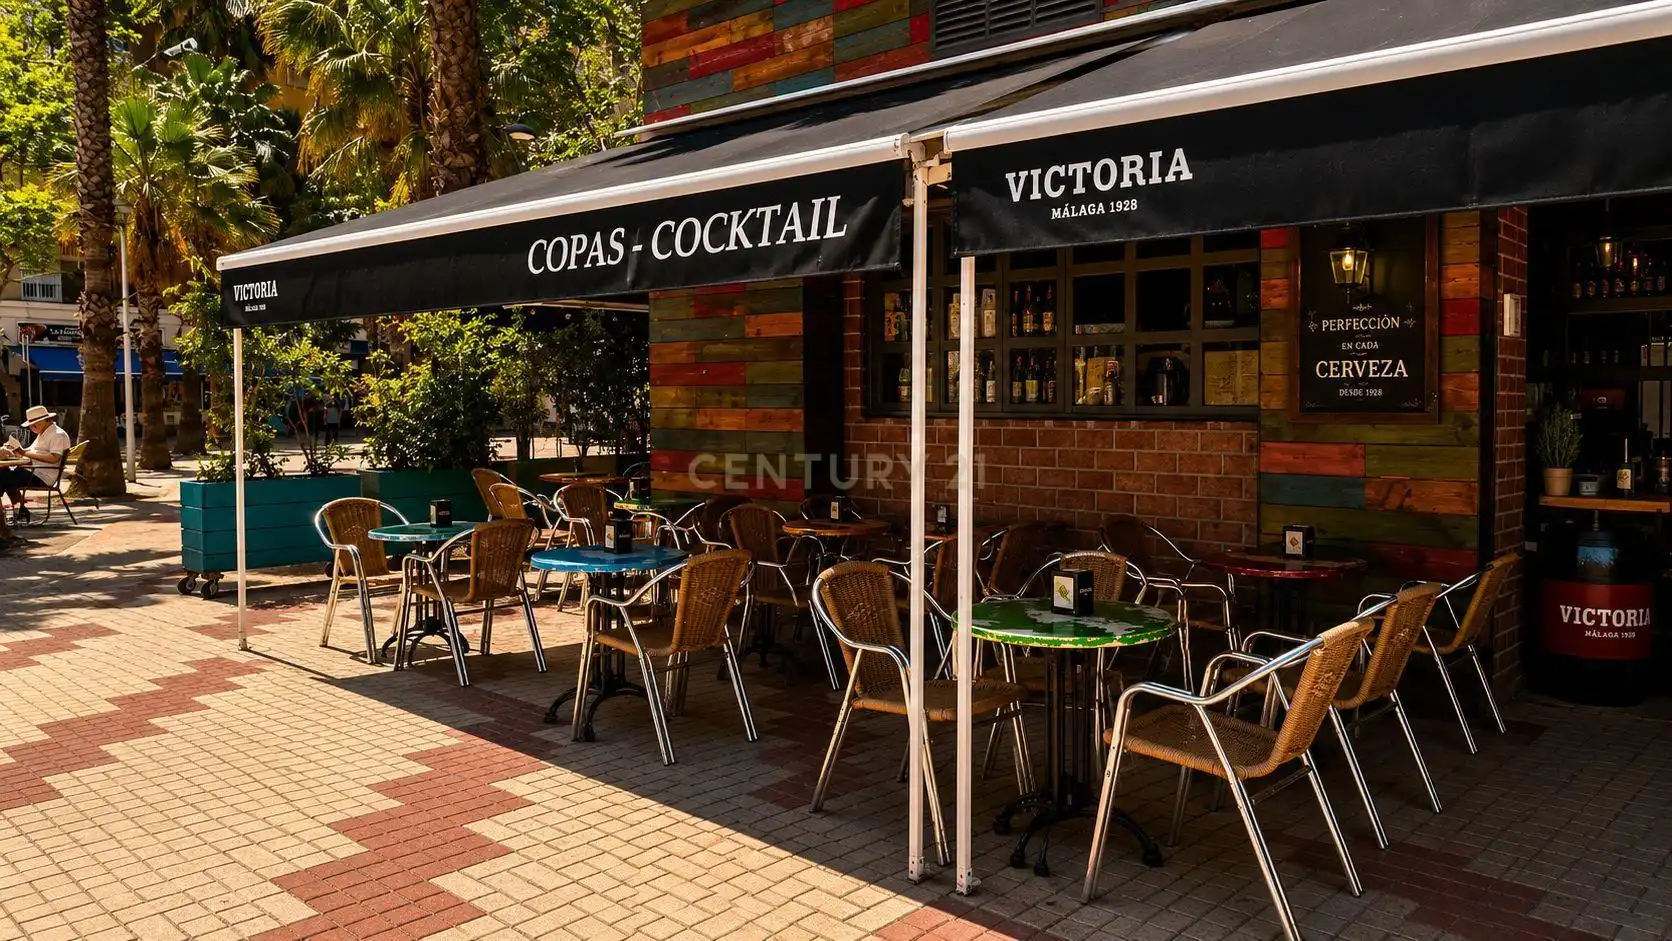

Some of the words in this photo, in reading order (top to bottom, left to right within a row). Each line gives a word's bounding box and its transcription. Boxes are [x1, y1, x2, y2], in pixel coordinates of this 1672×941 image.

[1005, 148, 1193, 202] VICTORIA
[1051, 203, 1105, 219] MÁLAGA
[1110, 199, 1138, 213] 1928
[527, 227, 625, 275] COPAS
[632, 243, 643, 252] -
[651, 195, 848, 260] COCKTAIL
[233, 280, 278, 301] VICTORIA
[1322, 315, 1400, 331] PERFECCIÓN
[1341, 342, 1353, 350] EN
[1355, 341, 1379, 350] CADA
[1315, 360, 1408, 378] CERVEZA
[1559, 604, 1651, 627] VICTORIA
